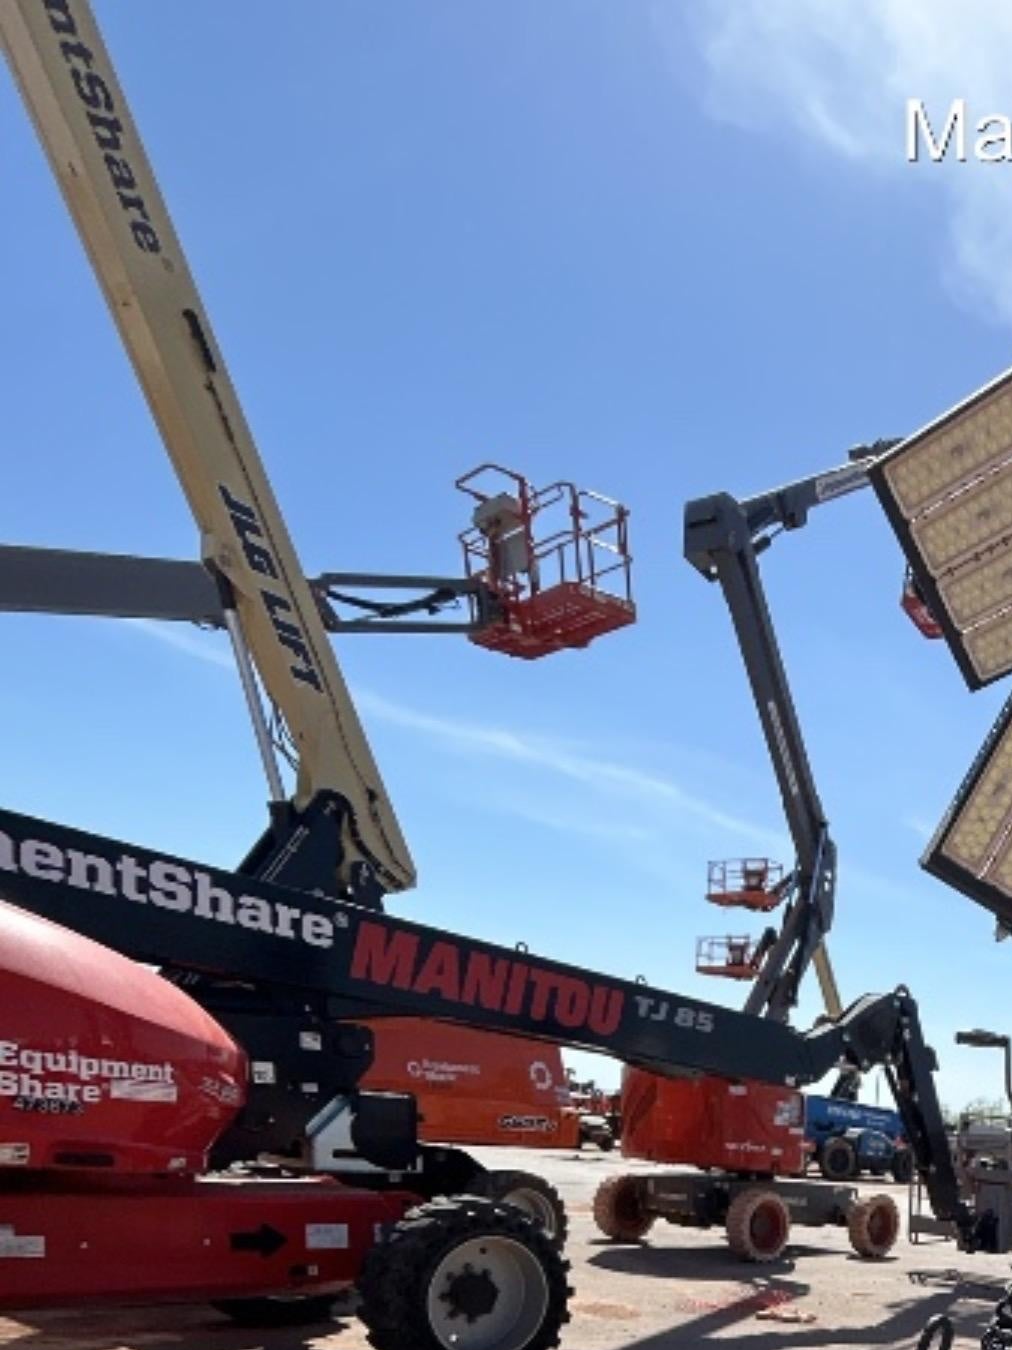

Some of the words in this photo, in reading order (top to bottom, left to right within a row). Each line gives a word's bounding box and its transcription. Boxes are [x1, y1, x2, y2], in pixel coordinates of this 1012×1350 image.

[218, 483, 280, 580] JLG
[260, 589, 325, 694] LIFT
[0, 829, 334, 949] entShare
[350, 920, 626, 1037] MANITOU
[635, 996, 668, 1022] TJ
[674, 1007, 714, 1033] 85
[0, 1040, 175, 1084] Equipment
[0, 1071, 102, 1103] Share
